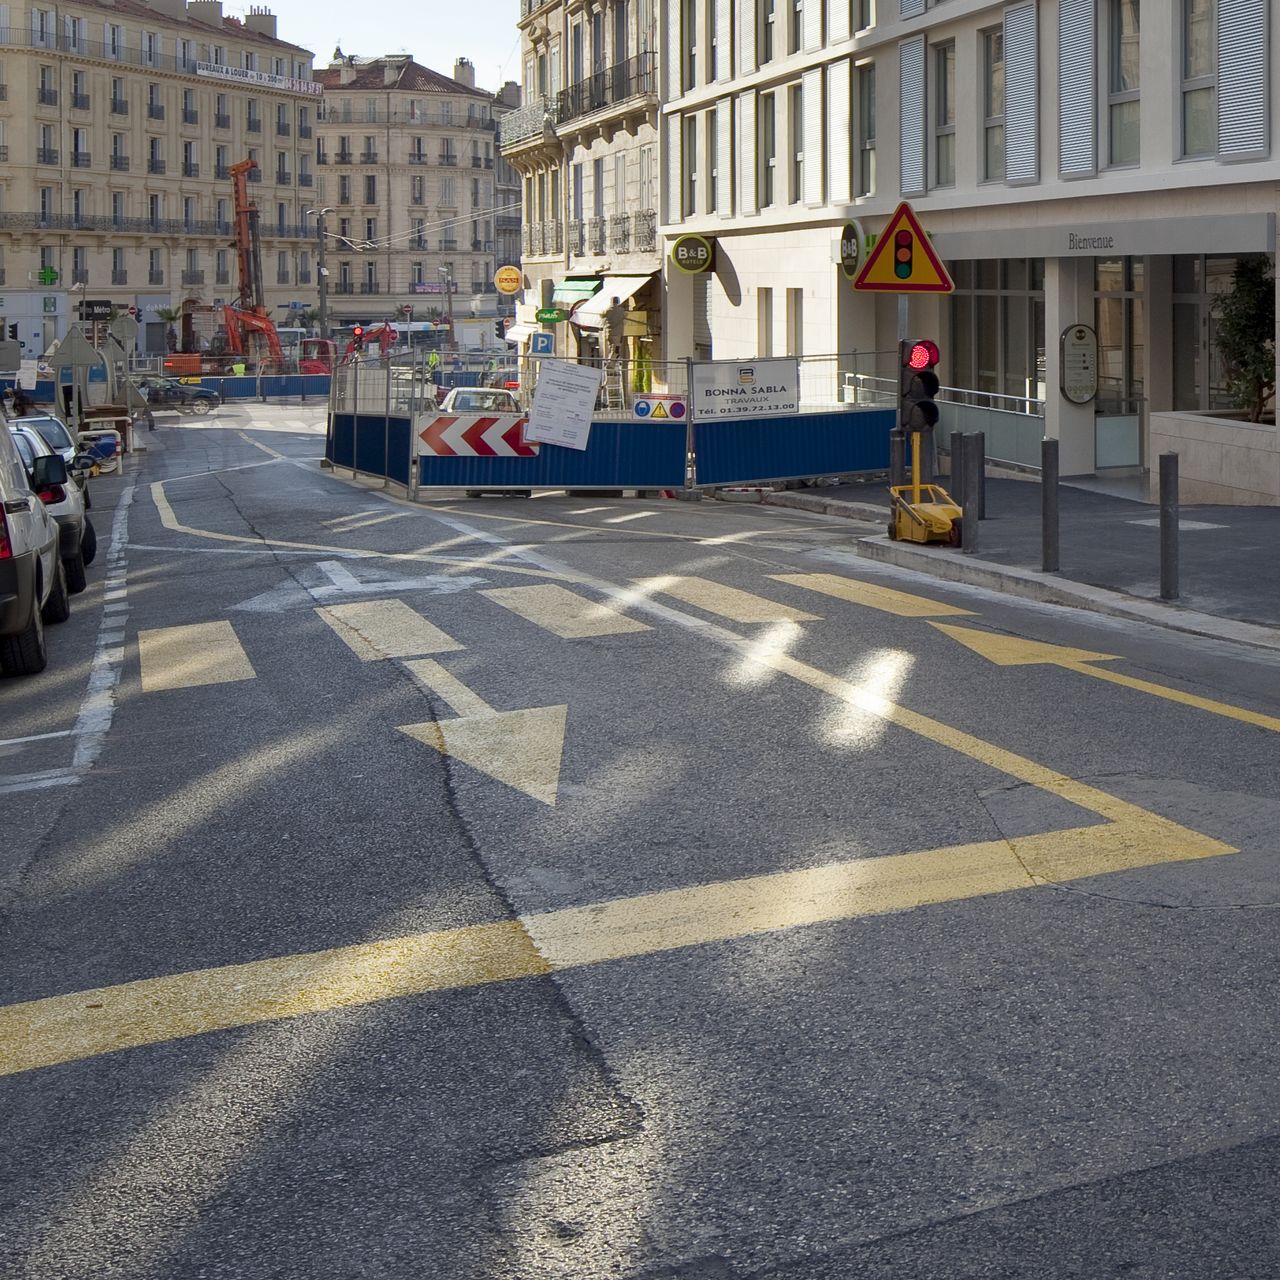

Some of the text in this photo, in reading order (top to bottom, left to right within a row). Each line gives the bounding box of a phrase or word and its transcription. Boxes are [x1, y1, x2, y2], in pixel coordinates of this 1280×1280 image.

[198, 62, 224, 74] BUREAUX
[231, 68, 249, 78] LOUER
[1068, 233, 1114, 249] Bienvenue
[678, 247, 707, 259] B&B
[842, 239, 858, 257] B&B
[537, 337, 548, 350] P
[705, 385, 787, 397] BONNA SABLA
[725, 396, 769, 405] TRAVAUX
